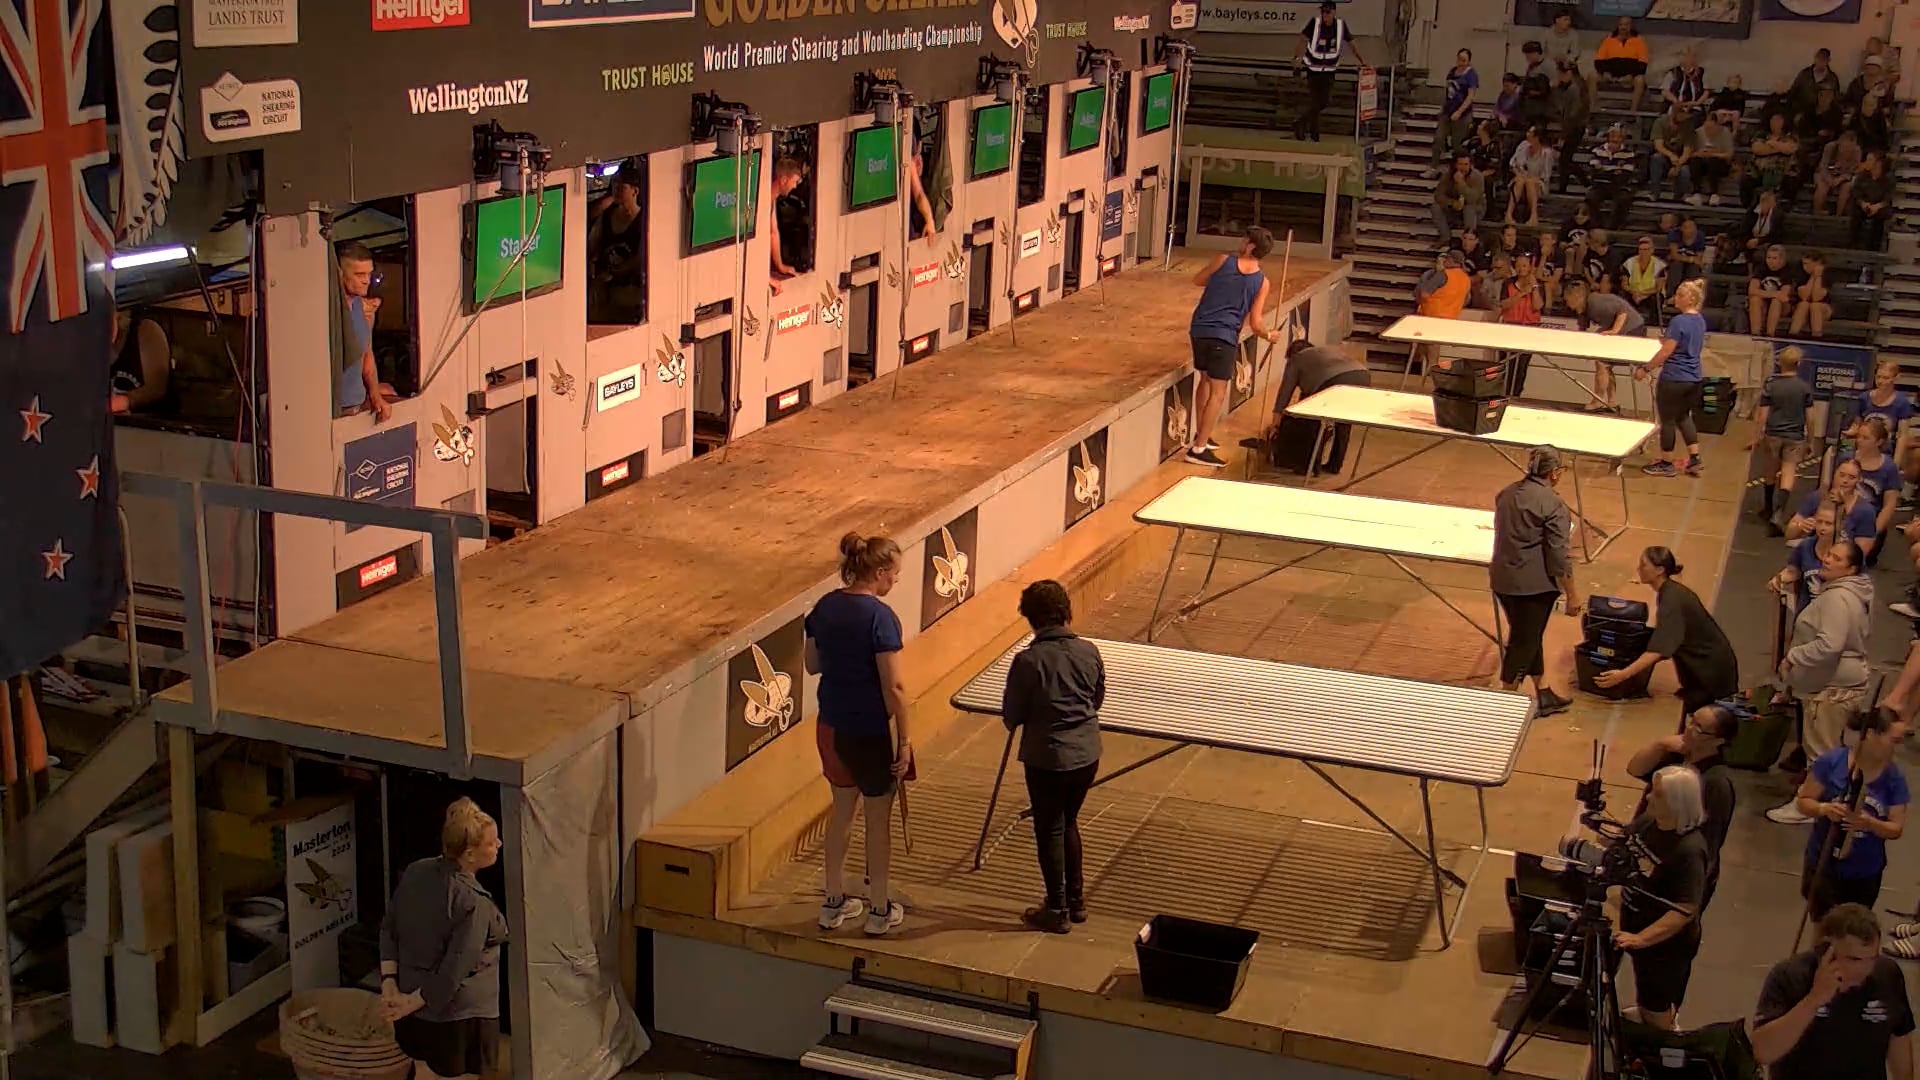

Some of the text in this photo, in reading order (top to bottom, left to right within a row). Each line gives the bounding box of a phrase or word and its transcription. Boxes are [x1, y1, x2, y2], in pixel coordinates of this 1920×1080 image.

[208, 10, 285, 26] LANDS TRUST
[703, 20, 982, 73] World Premier Shearing and Woolhandling Championship
[602, 62, 695, 91] TRUST HOUSE
[262, 89, 295, 101] NATIONAL
[408, 79, 529, 114] WellingtonNZ
[262, 113, 289, 125] CIRCUIT
[604, 378, 634, 397] BAYLEYS
[292, 821, 352, 858] Masterton
